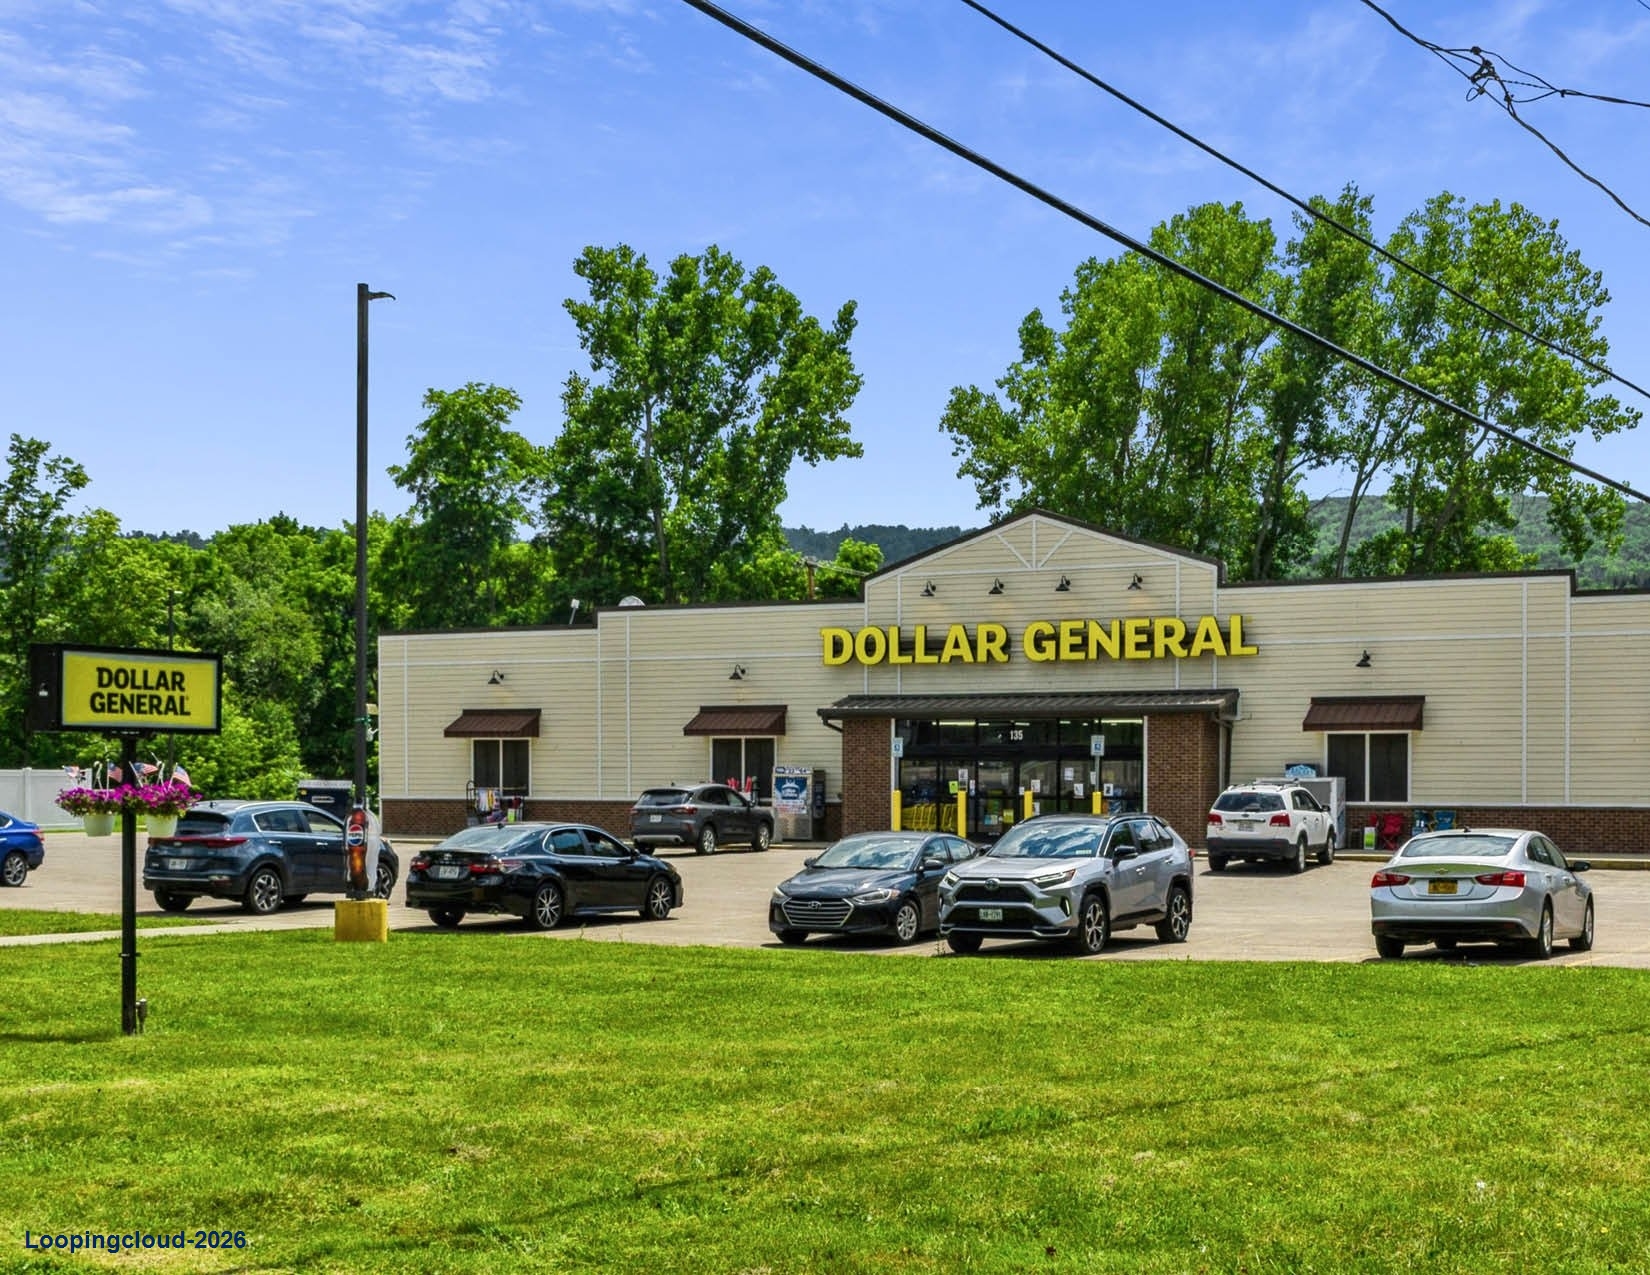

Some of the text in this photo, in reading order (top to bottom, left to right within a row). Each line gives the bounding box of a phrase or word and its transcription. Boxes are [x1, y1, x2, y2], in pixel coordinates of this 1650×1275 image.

[820, 615, 1259, 666] DOLLAR GENERAL
[96, 667, 185, 692] DOLLAR
[90, 691, 191, 716] GENERAL
[1010, 730, 1024, 740] 135
